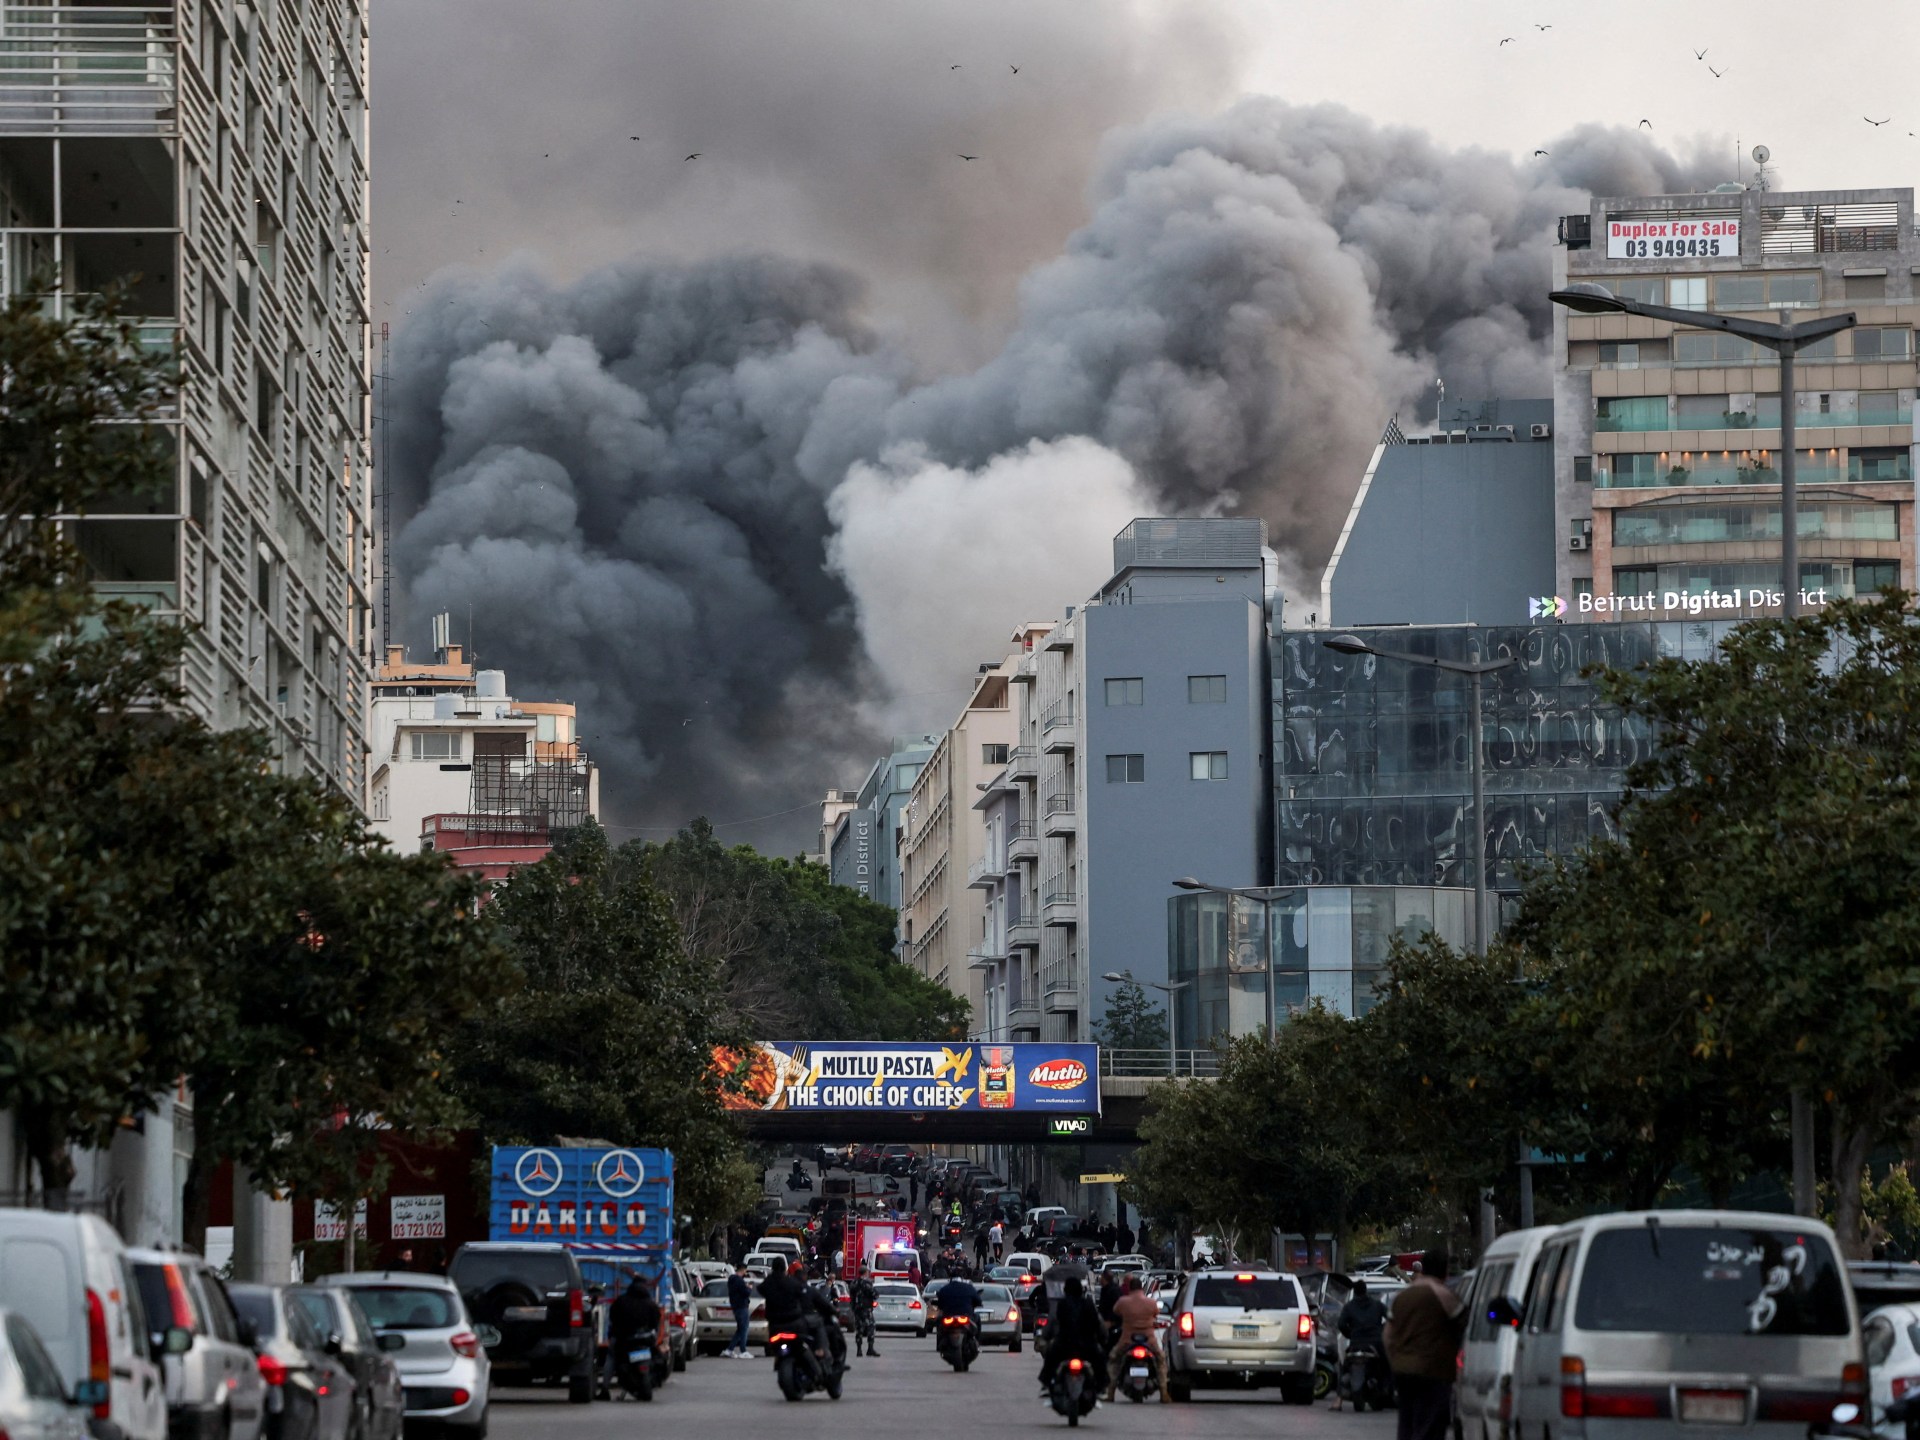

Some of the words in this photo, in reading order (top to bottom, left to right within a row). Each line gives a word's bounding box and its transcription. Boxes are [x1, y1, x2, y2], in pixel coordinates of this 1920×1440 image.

[1612, 222, 1667, 240] Duplex
[1671, 223, 1697, 236] For
[1702, 221, 1737, 236] Sale
[1625, 240, 1647, 257] 03
[1653, 239, 1720, 257] 949435
[1578, 590, 1656, 613] Beirut
[1663, 588, 1741, 615] Digital
[1749, 587, 1827, 608] Disict
[856, 821, 869, 875] District
[822, 1056, 878, 1076] MUTLU
[883, 1056, 934, 1076] PASTA
[1029, 1063, 1084, 1083] Mutlu
[786, 1085, 818, 1106] THE
[822, 1085, 883, 1106] CHOICE
[887, 1085, 908, 1106] OF
[913, 1085, 964, 1107] CHEFS
[316, 1224, 327, 1238] 03
[393, 1223, 405, 1237] 03
[407, 1223, 424, 1237] 723
[426, 1222, 443, 1236] 022
